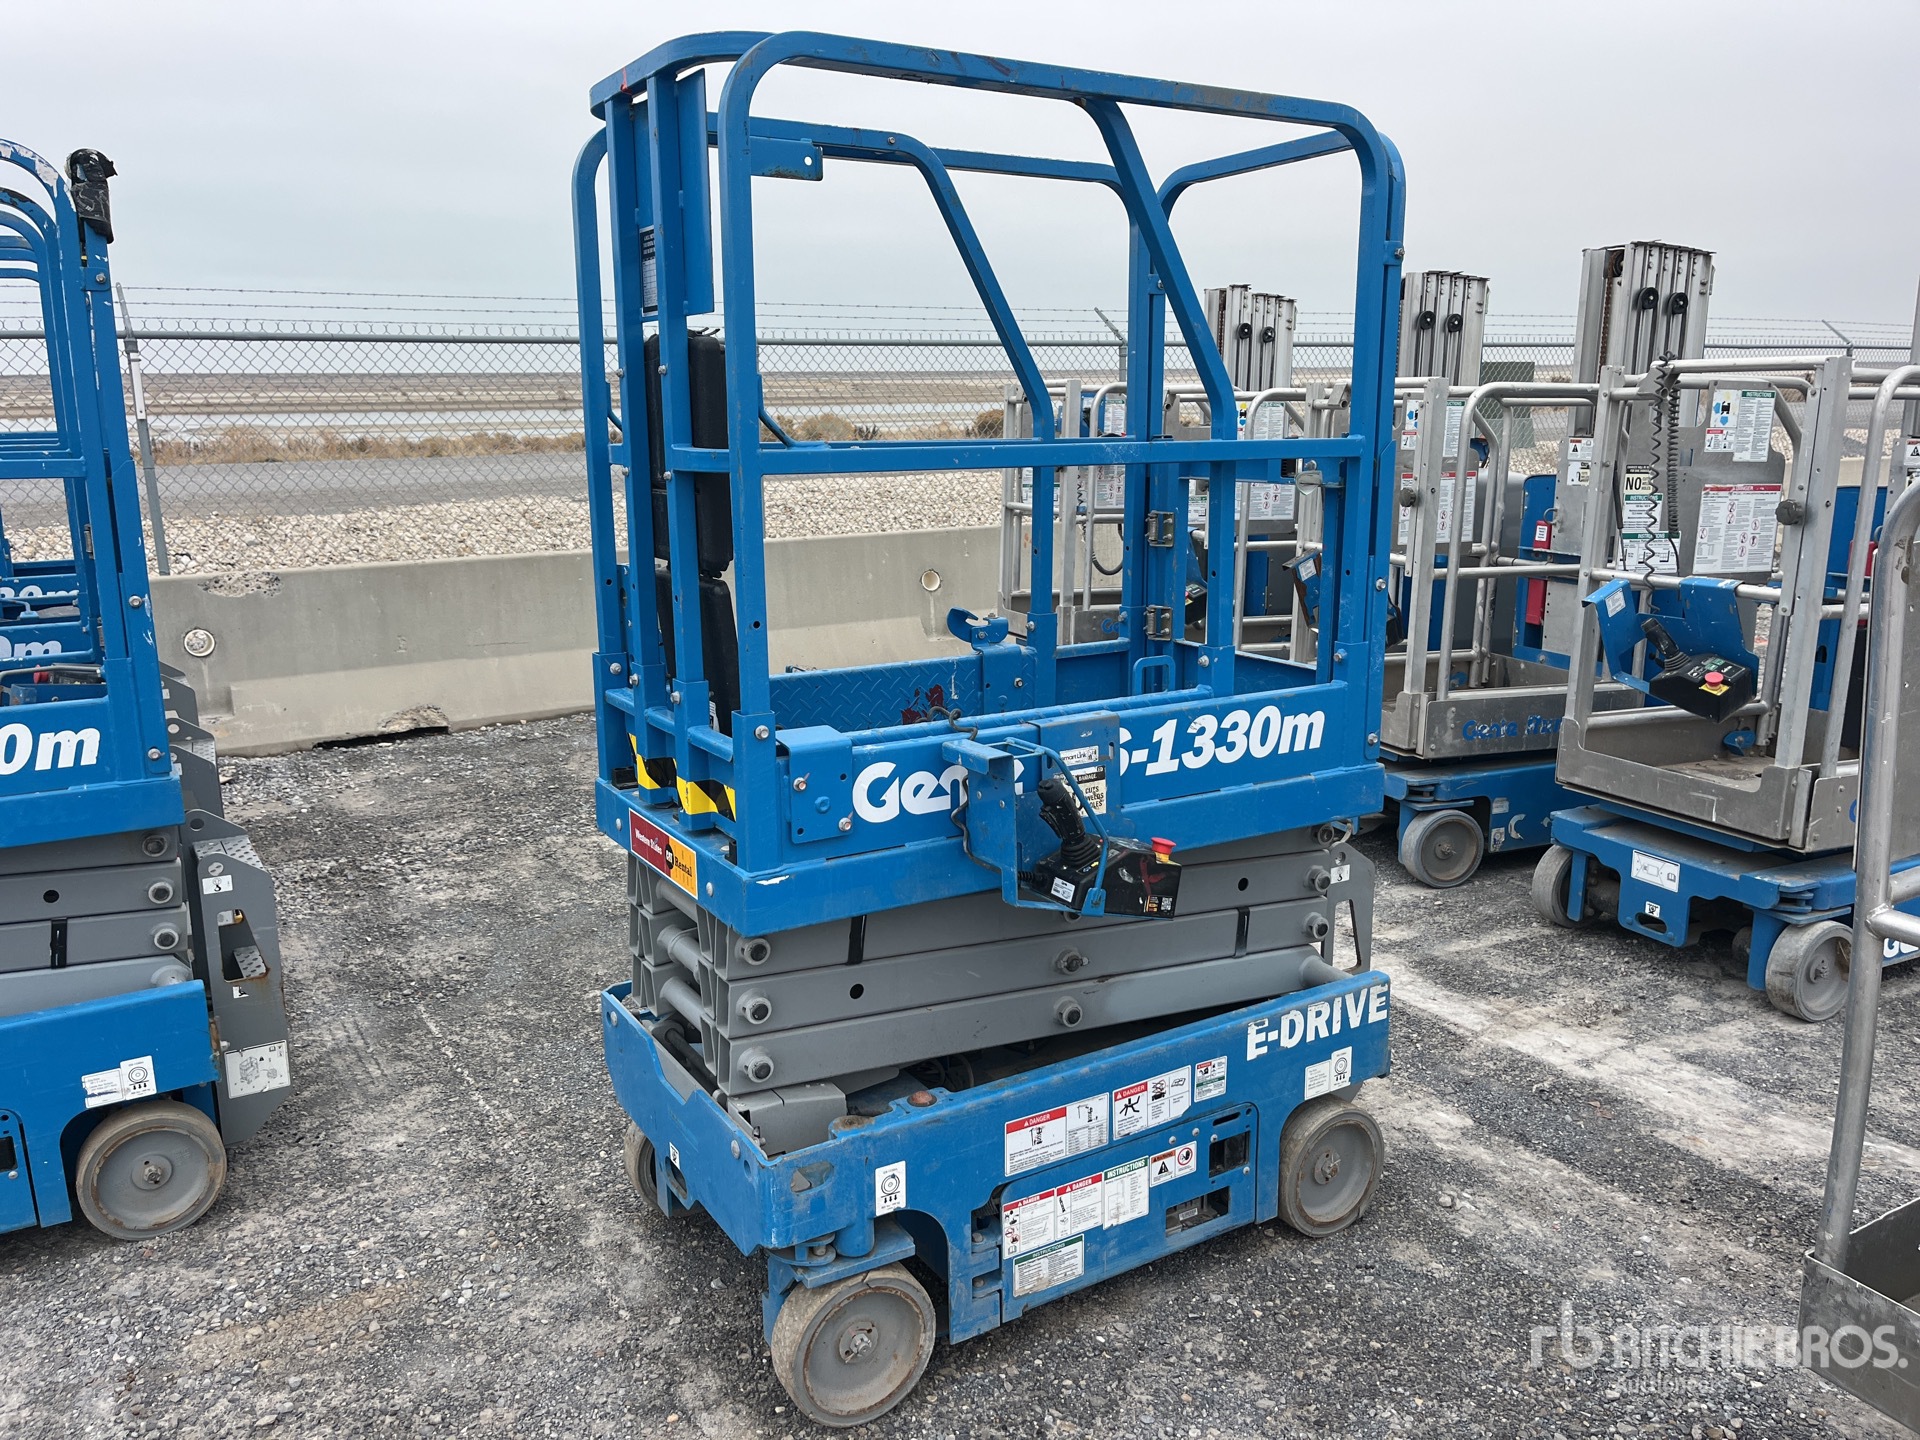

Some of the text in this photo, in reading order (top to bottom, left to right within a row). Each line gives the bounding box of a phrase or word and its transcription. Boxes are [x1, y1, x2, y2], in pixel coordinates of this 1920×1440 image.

[1625, 476, 1642, 491] NO
[674, 856, 693, 877] Rental
[1246, 983, 1389, 1061] E-DRIVE
[1122, 1085, 1145, 1097] DANGER
[1029, 1113, 1051, 1125] DANGER
[1107, 1159, 1146, 1178] INSTRUCTIONS
[1072, 1179, 1093, 1190] DANGER
[1022, 1195, 1040, 1206] DANGER
